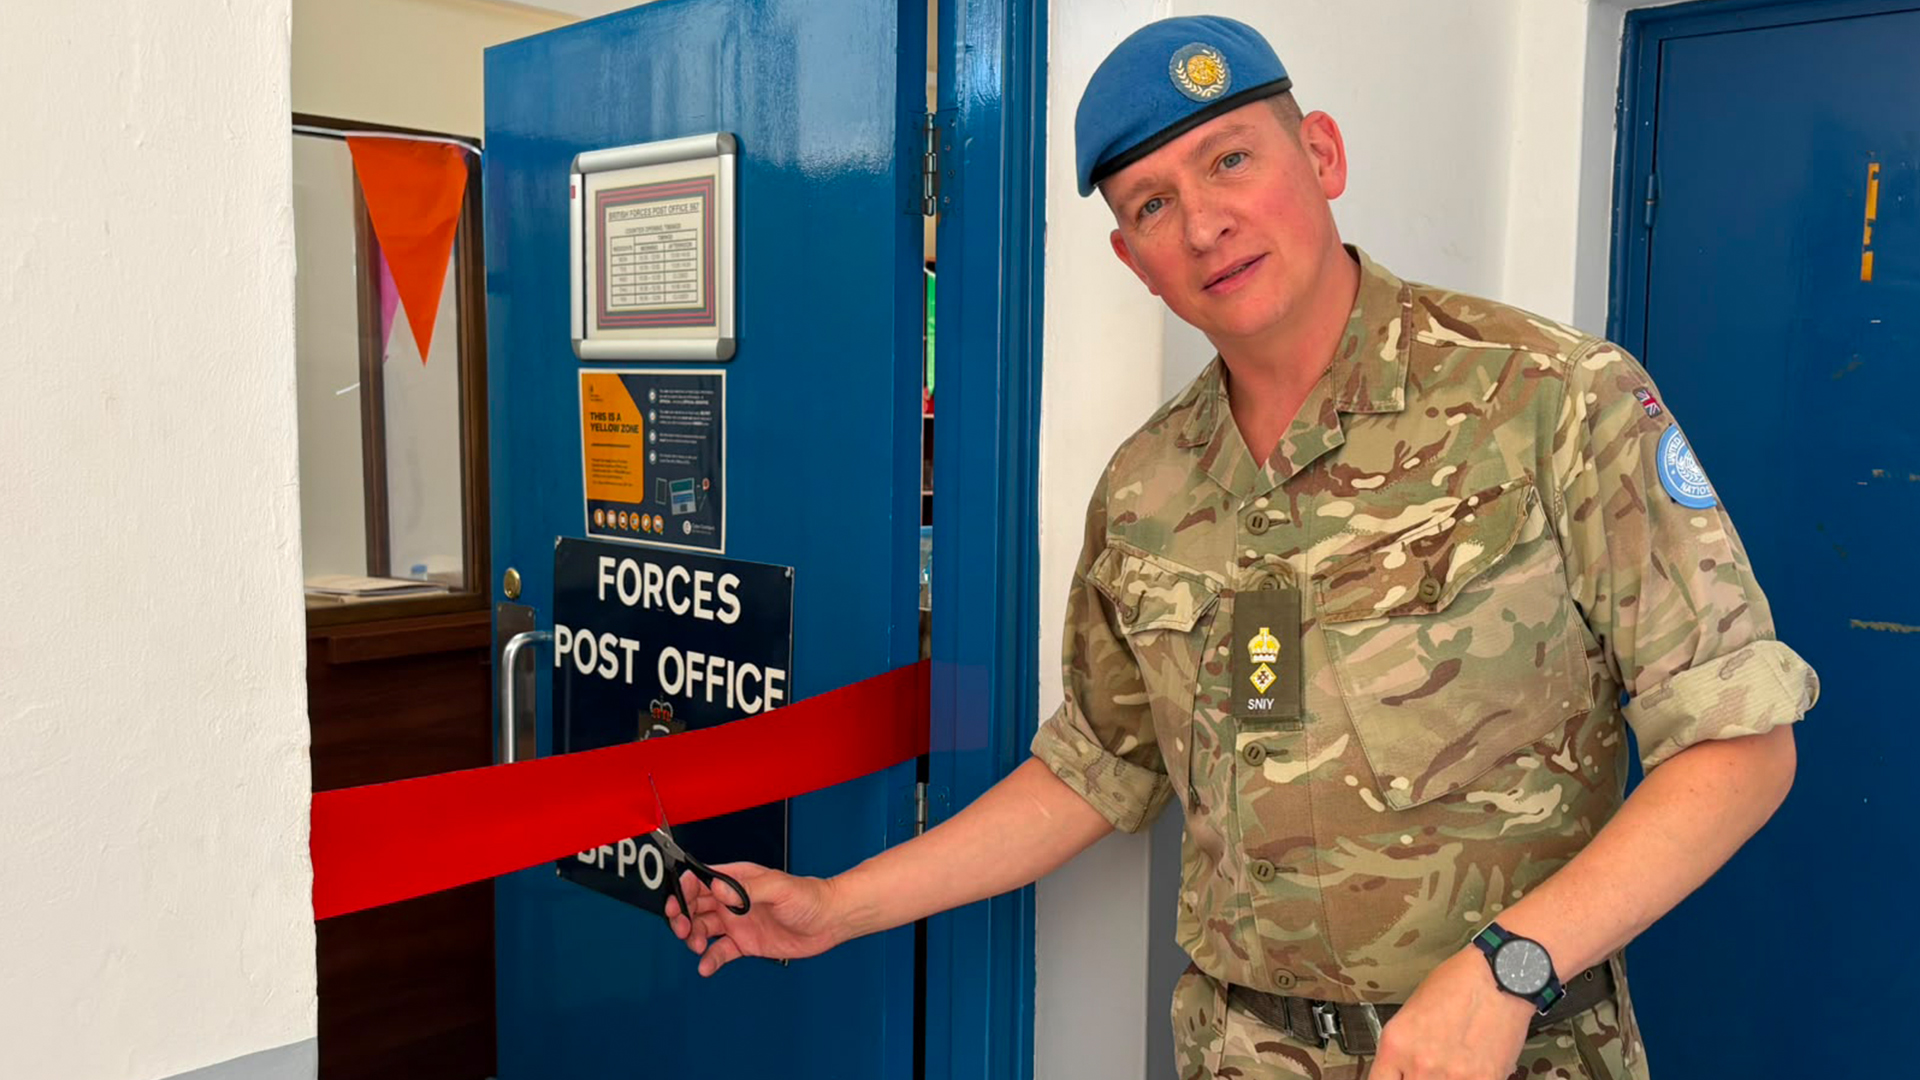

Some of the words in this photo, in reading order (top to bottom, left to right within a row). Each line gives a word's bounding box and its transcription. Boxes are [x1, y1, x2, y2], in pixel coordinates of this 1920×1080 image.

[629, 208, 652, 218] FORCES
[653, 205, 667, 215] POST
[668, 203, 688, 213] OFFICE
[590, 412, 606, 421] THIS
[608, 412, 615, 422] IS
[616, 413, 622, 422] A
[590, 423, 620, 433] YELLOW
[621, 424, 639, 434] ZONE
[598, 556, 741, 625] FORCES
[554, 624, 640, 684] POST
[658, 646, 786, 714] OFFICE
[1247, 698, 1275, 710] SNIY
